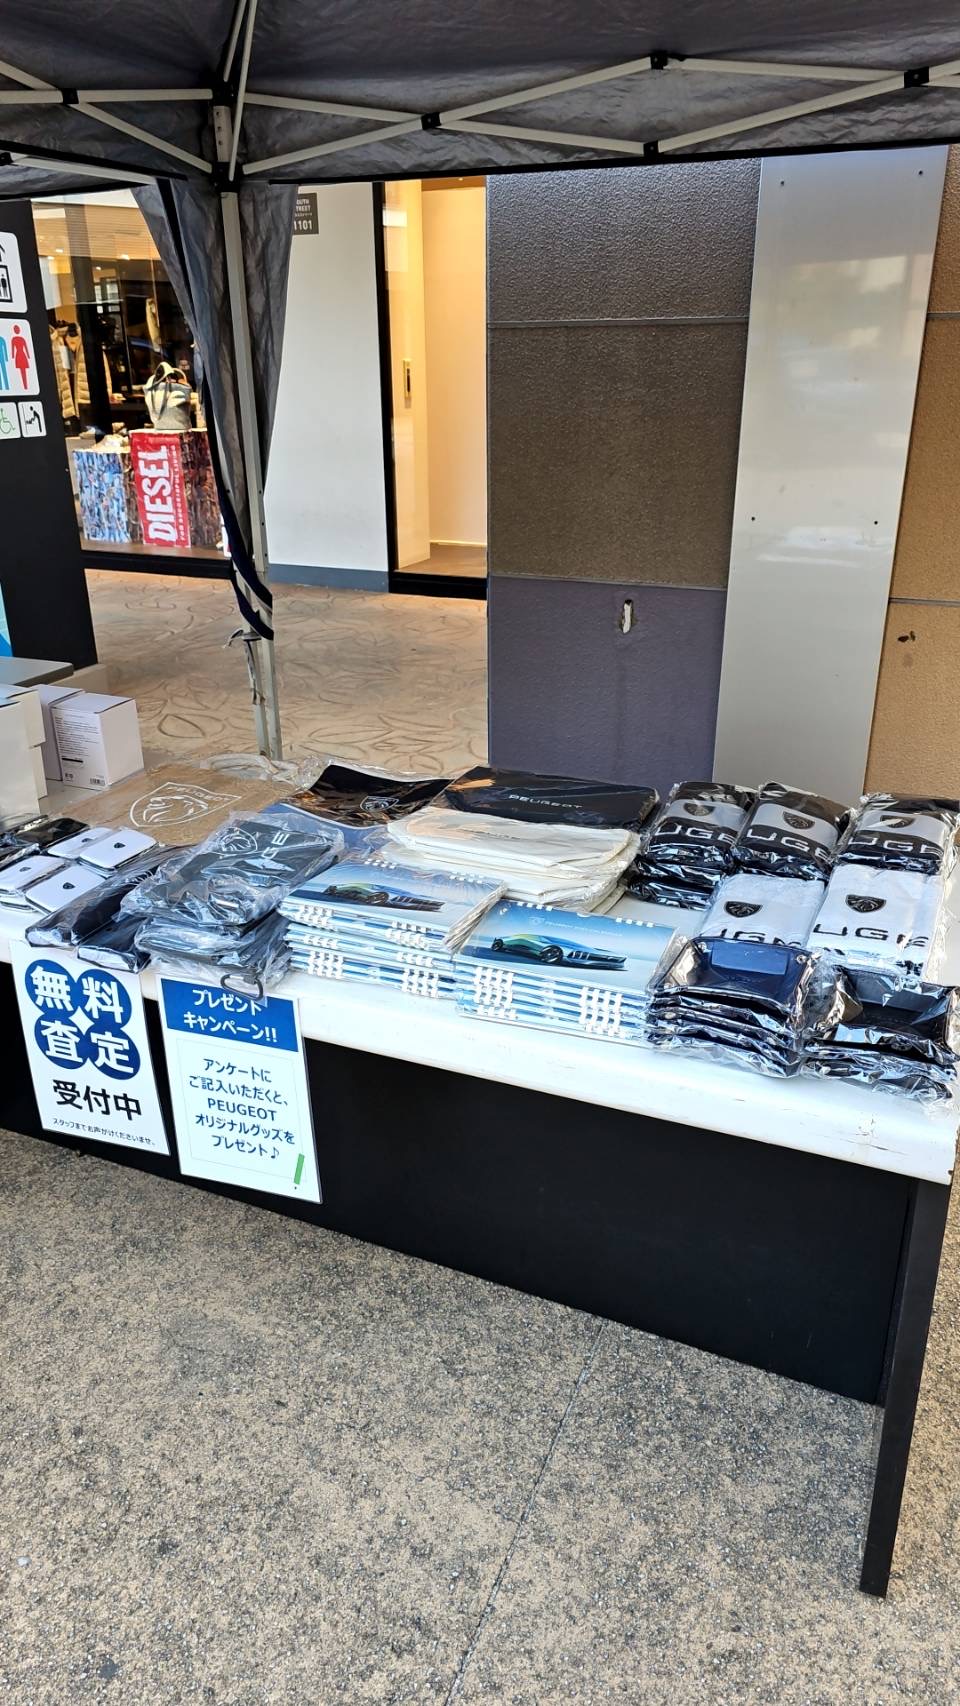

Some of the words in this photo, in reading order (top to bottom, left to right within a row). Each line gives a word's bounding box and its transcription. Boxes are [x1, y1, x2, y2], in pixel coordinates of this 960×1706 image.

[137, 445, 178, 542] DIESEL
[508, 794, 583, 809] PEUGEOT
[30, 965, 125, 1024] 無料
[192, 988, 263, 1016] プレゼント
[183, 1011, 278, 1043] キャンペーン!!
[40, 1019, 135, 1074] 査定
[203, 1058, 273, 1083] アンケートに
[52, 1079, 142, 1121] 受付中
[188, 1074, 288, 1106] ご記入いただくと、
[207, 1097, 277, 1121] PEUGEOT
[195, 1113, 296, 1145] オリジナルグッズを
